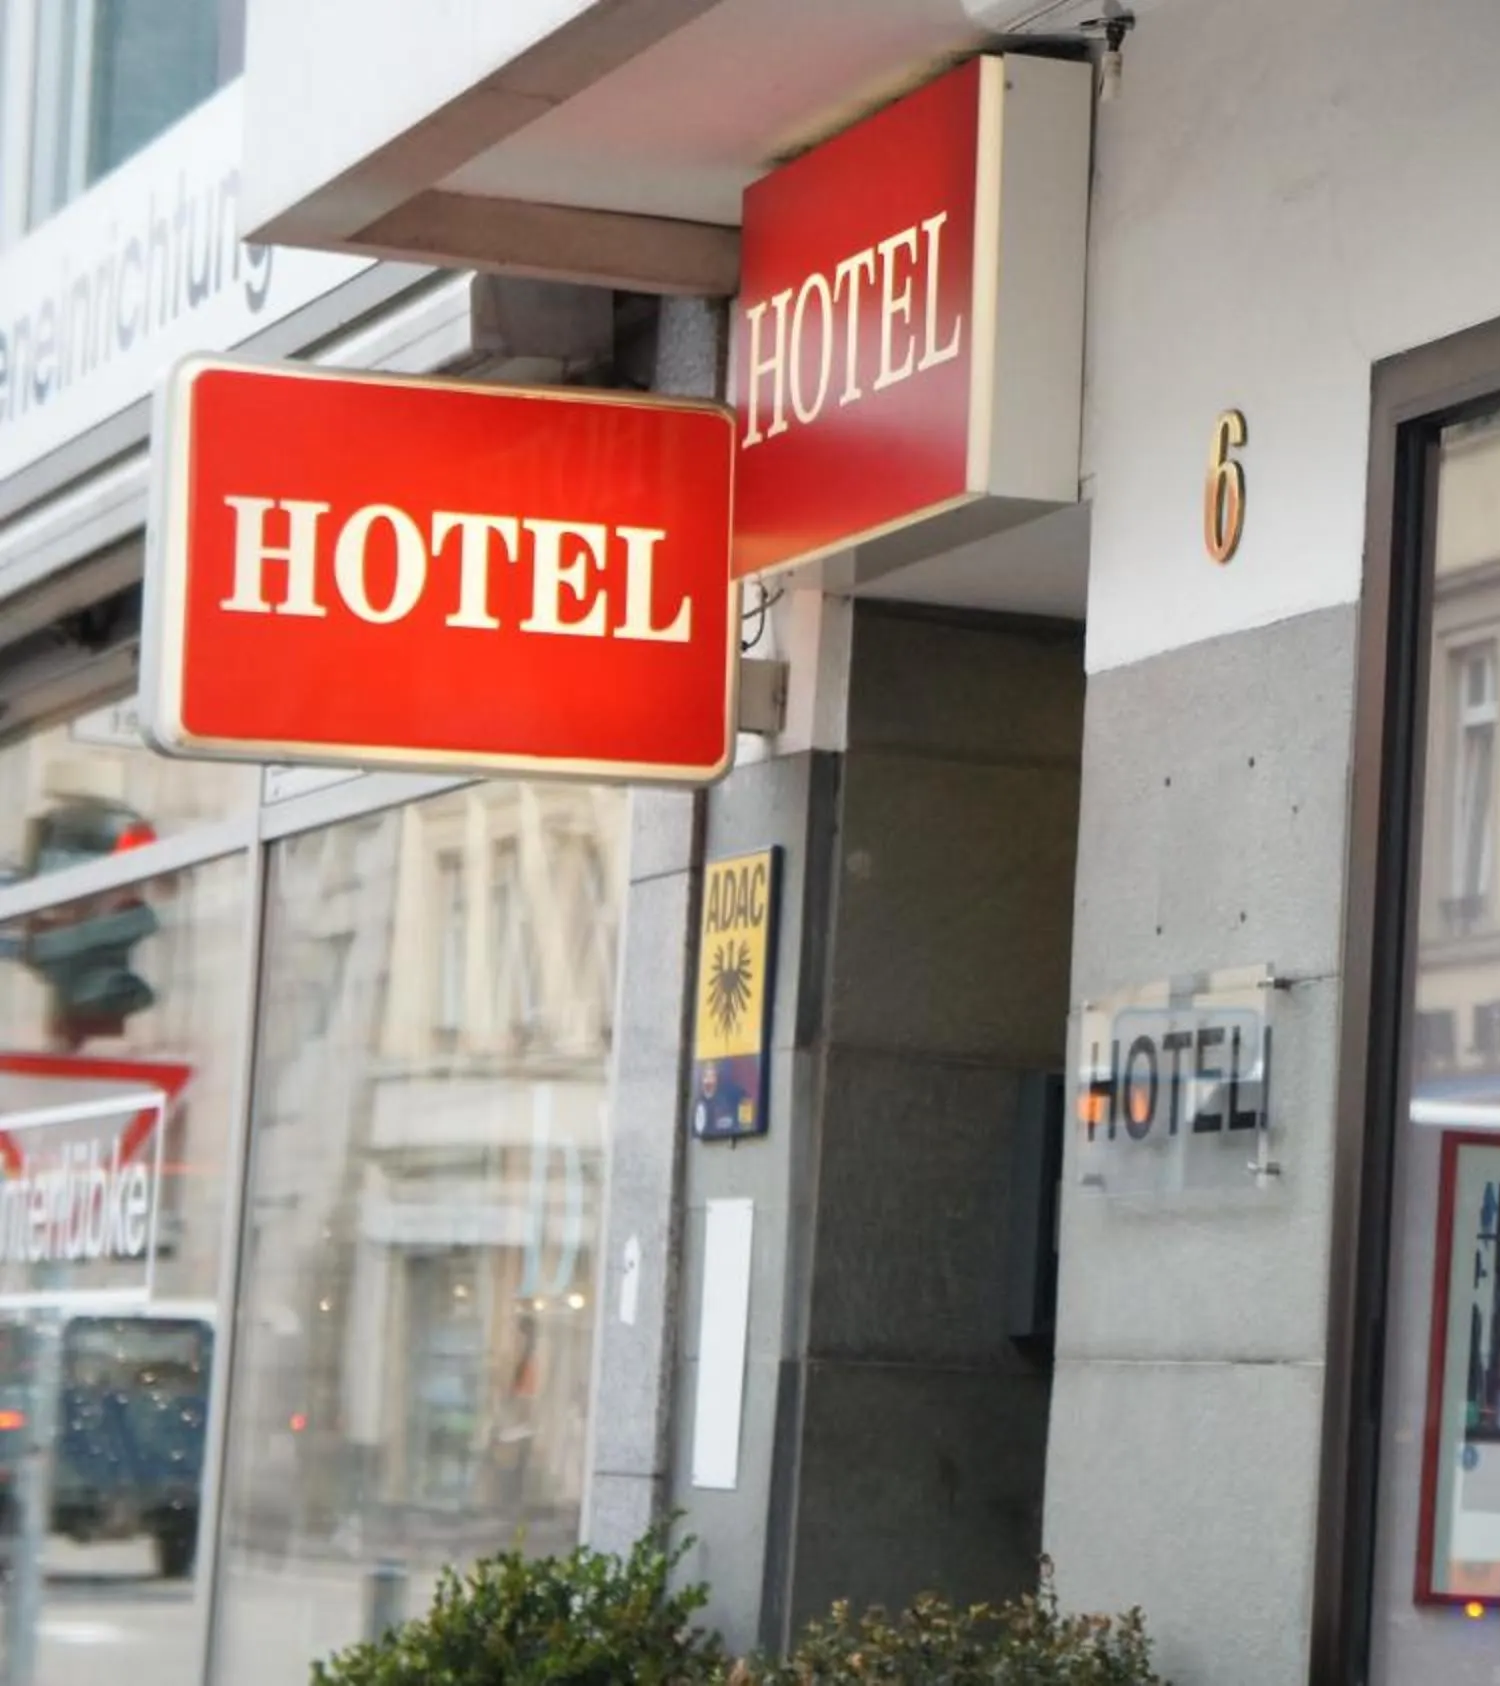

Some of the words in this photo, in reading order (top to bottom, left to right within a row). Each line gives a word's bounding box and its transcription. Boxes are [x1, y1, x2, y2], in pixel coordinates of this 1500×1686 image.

[741, 209, 963, 450] HOTEL
[1203, 408, 1248, 566] 6
[218, 494, 692, 643] HOTEL
[705, 862, 766, 933] ADAC
[1086, 1024, 1258, 1142] HOTEL
